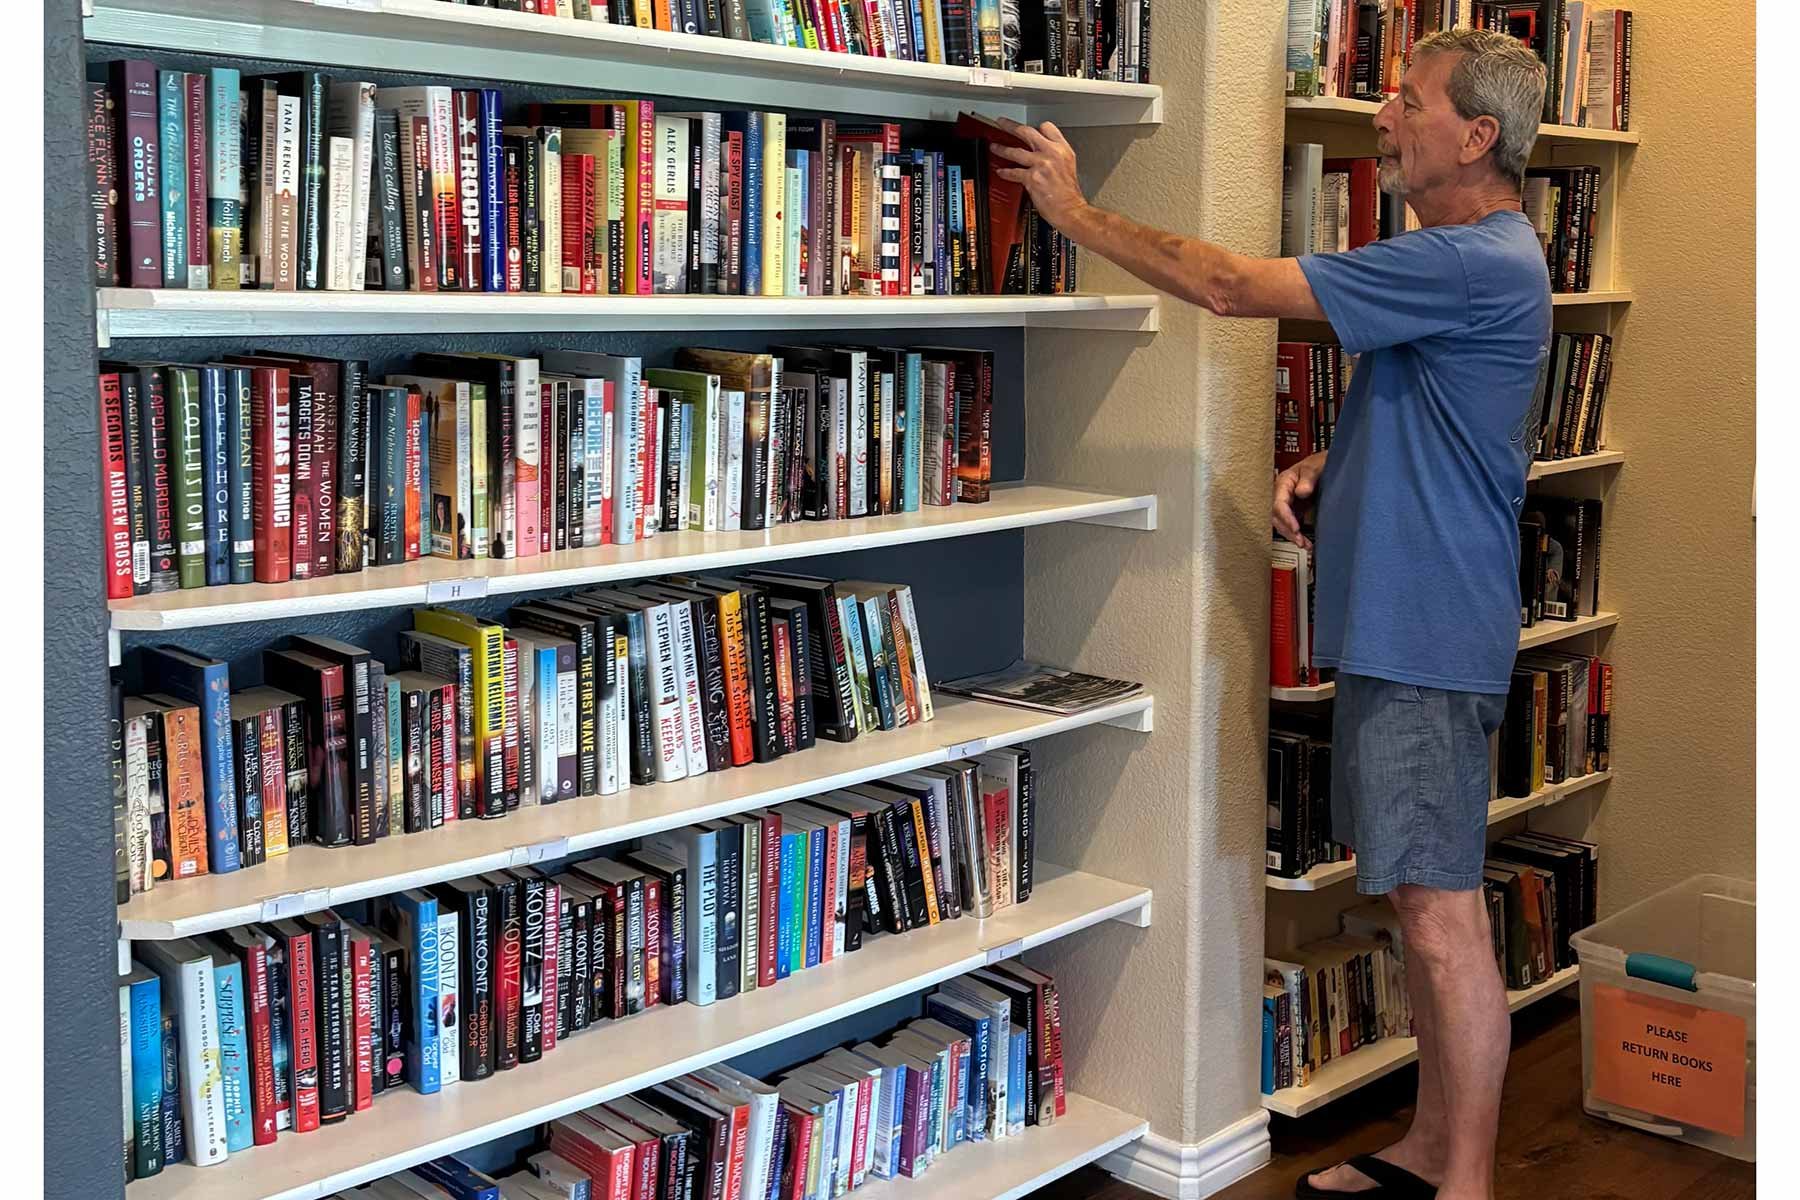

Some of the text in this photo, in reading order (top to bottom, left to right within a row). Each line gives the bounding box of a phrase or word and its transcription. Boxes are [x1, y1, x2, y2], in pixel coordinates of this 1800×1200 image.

[93, 90, 107, 185] VINCE FLYNN
[282, 104, 293, 184] TANA FRENCH
[667, 128, 676, 194] ALEX GERLIS
[134, 137, 145, 202] ORDERS
[146, 144, 155, 197] UNDER
[458, 118, 480, 236] X TROOP
[731, 136, 740, 211] THE SPY COAST
[748, 173, 756, 185] we
[96, 214, 105, 262] RED WAR
[510, 184, 519, 246] LISA GARDNER
[748, 210, 757, 244] wanted
[914, 199, 922, 254] GRAFTON
[280, 204, 290, 282] IN THE WOODS
[510, 264, 520, 290] HIDE
[857, 361, 865, 439] TAMI HOAG
[947, 372, 955, 390] Days
[240, 387, 251, 467] ORPHAN
[298, 385, 311, 480] TARGETS DOWN
[314, 392, 325, 453] HANNAH
[352, 396, 360, 424] FOUR
[759, 392, 767, 442] UNBROKEN
[151, 395, 170, 540] APOLLO MURDERS
[351, 428, 359, 462] WINDS
[413, 420, 421, 492] HOME FRONT
[587, 397, 602, 509] BEFORE FALL
[669, 398, 681, 519] JACK HIGGINS RAIN DEAD
[104, 380, 130, 576] 15 SECONDS ANDREW GROSS
[298, 514, 307, 545] HAMER
[319, 481, 331, 542] WOMEN
[390, 504, 398, 542] KRISTIN
[452, 586, 460, 596] H
[656, 612, 675, 699] STEPHEN KING
[703, 614, 724, 704] STEPHEN KING
[728, 641, 737, 682] AFTER
[758, 597, 776, 746] STEPHEN KING OUTSIDER
[487, 634, 504, 794] JONATHAN KELLERMAN TRUE DETECTIVES
[582, 656, 593, 752] THE FIRST WAVE
[708, 712, 723, 746] SLEEP
[732, 684, 744, 730] SUNSET
[217, 737, 225, 759] Sophie
[431, 710, 443, 791] IRIS JOHANSEN
[661, 718, 674, 762] KEEPERS
[961, 748, 967, 756] K
[244, 753, 253, 792] JACKSON
[262, 751, 275, 786] JACKSON
[360, 783, 369, 838] MATT JACKSON
[885, 811, 898, 854] Rosemary
[702, 865, 714, 917] THE PLOT
[866, 877, 879, 915] WIDOWS
[476, 897, 488, 994] DEAN KOONTZ
[524, 887, 544, 962] KOONTZ
[593, 927, 605, 971] KOONTZ
[648, 912, 659, 957] KOONTZ
[296, 941, 307, 975] NEVER
[421, 926, 438, 997] KOONTZ
[439, 926, 456, 991] KOONTZ
[544, 888, 556, 1036] DEAN KOONTZ RELENTLESS
[576, 934, 588, 979] KOONTZ
[299, 980, 308, 1004] CALL
[300, 1009, 309, 1024] ME
[356, 973, 370, 1018] LEAVERS
[468, 1013, 479, 1047] DOOR
[479, 1000, 487, 1058] FORBIDDEN
[525, 1007, 535, 1044] Thomas
[533, 1013, 541, 1034] Odd
[1043, 988, 1052, 1059] HILARY MANTEL
[1646, 1024, 1688, 1043] PLEASE
[262, 1024, 273, 1105] ANDREW JACKSON
[301, 1038, 311, 1065] HERO
[359, 1036, 369, 1073] LISA KO
[424, 1046, 433, 1065] Odd
[980, 1022, 988, 1079] DEVOTION
[1622, 1041, 1713, 1072] RETURN BOOKS
[1651, 1072, 1682, 1087] HERE
[164, 1110, 174, 1160] KINGSBURY
[714, 1161, 724, 1194] JAMES
[731, 1128, 746, 1200] DEBBIE MACOM
